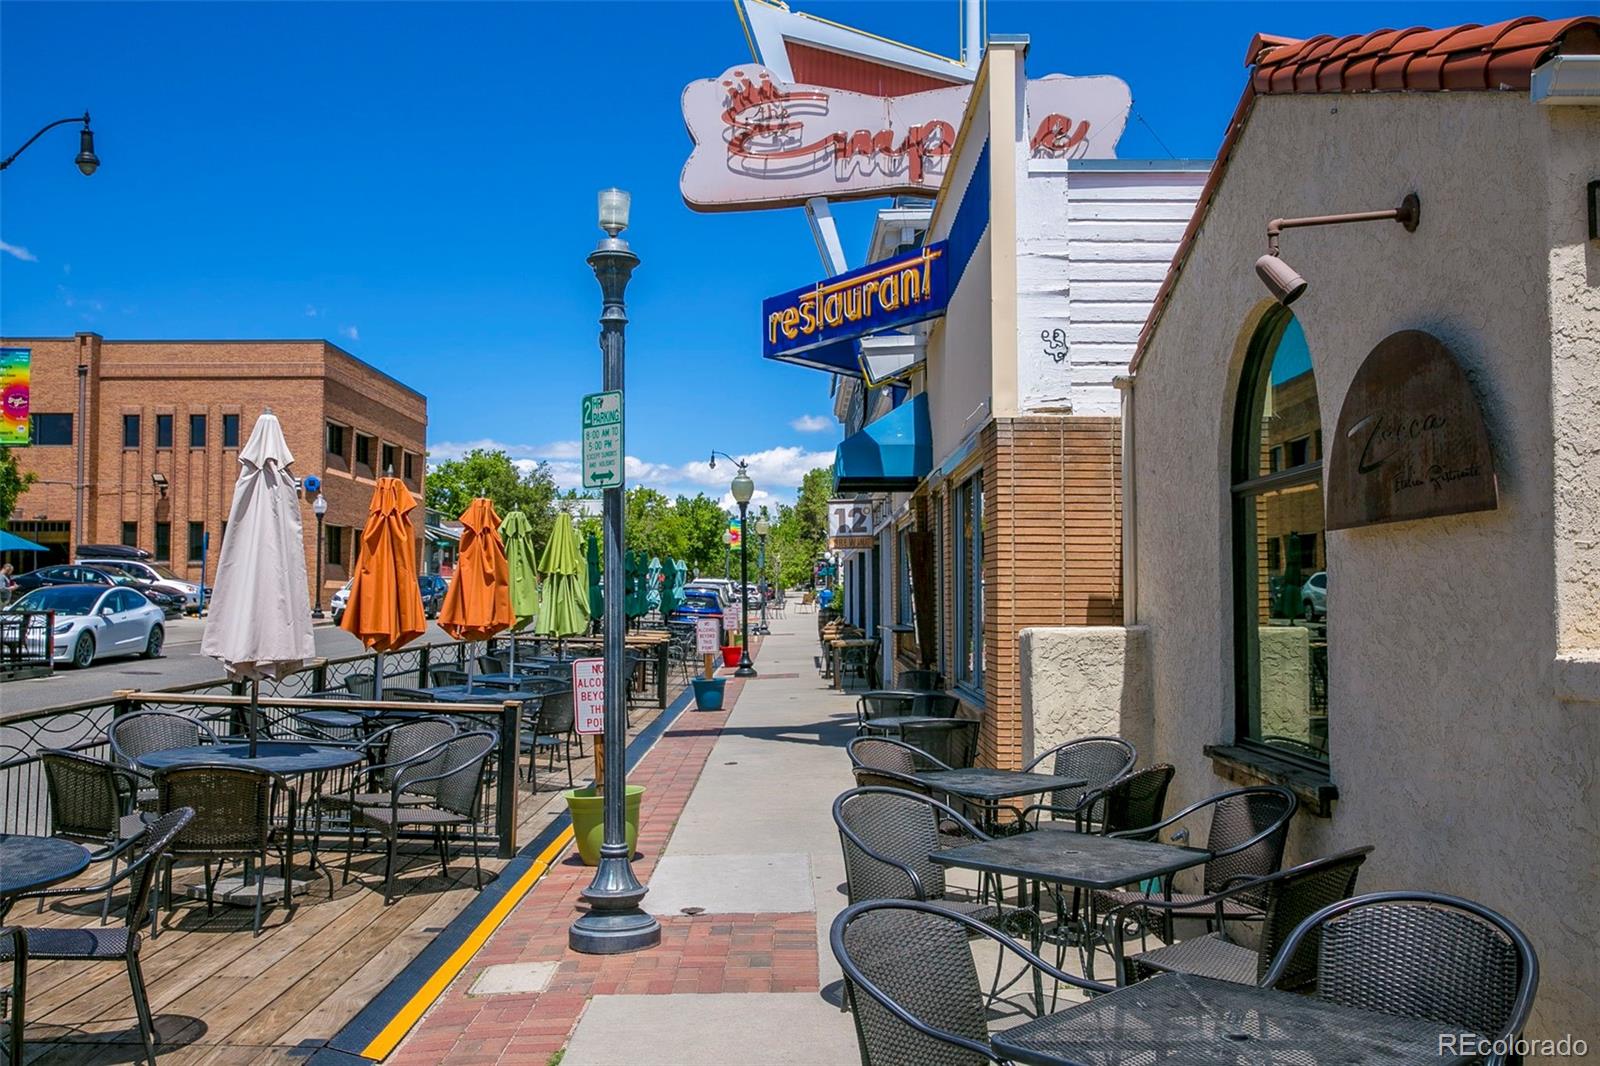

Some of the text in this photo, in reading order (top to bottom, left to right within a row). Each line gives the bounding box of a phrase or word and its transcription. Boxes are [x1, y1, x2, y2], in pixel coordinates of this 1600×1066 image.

[768, 247, 942, 344] restaurant
[584, 401, 591, 424] 2
[593, 408, 619, 423] PARKING
[601, 428, 610, 437] AM
[612, 426, 618, 436] TO
[604, 440, 612, 449] PM
[592, 665, 604, 673] NO
[578, 678, 604, 688] ALCO
[581, 691, 604, 701] BEYO
[587, 718, 602, 727] POI
